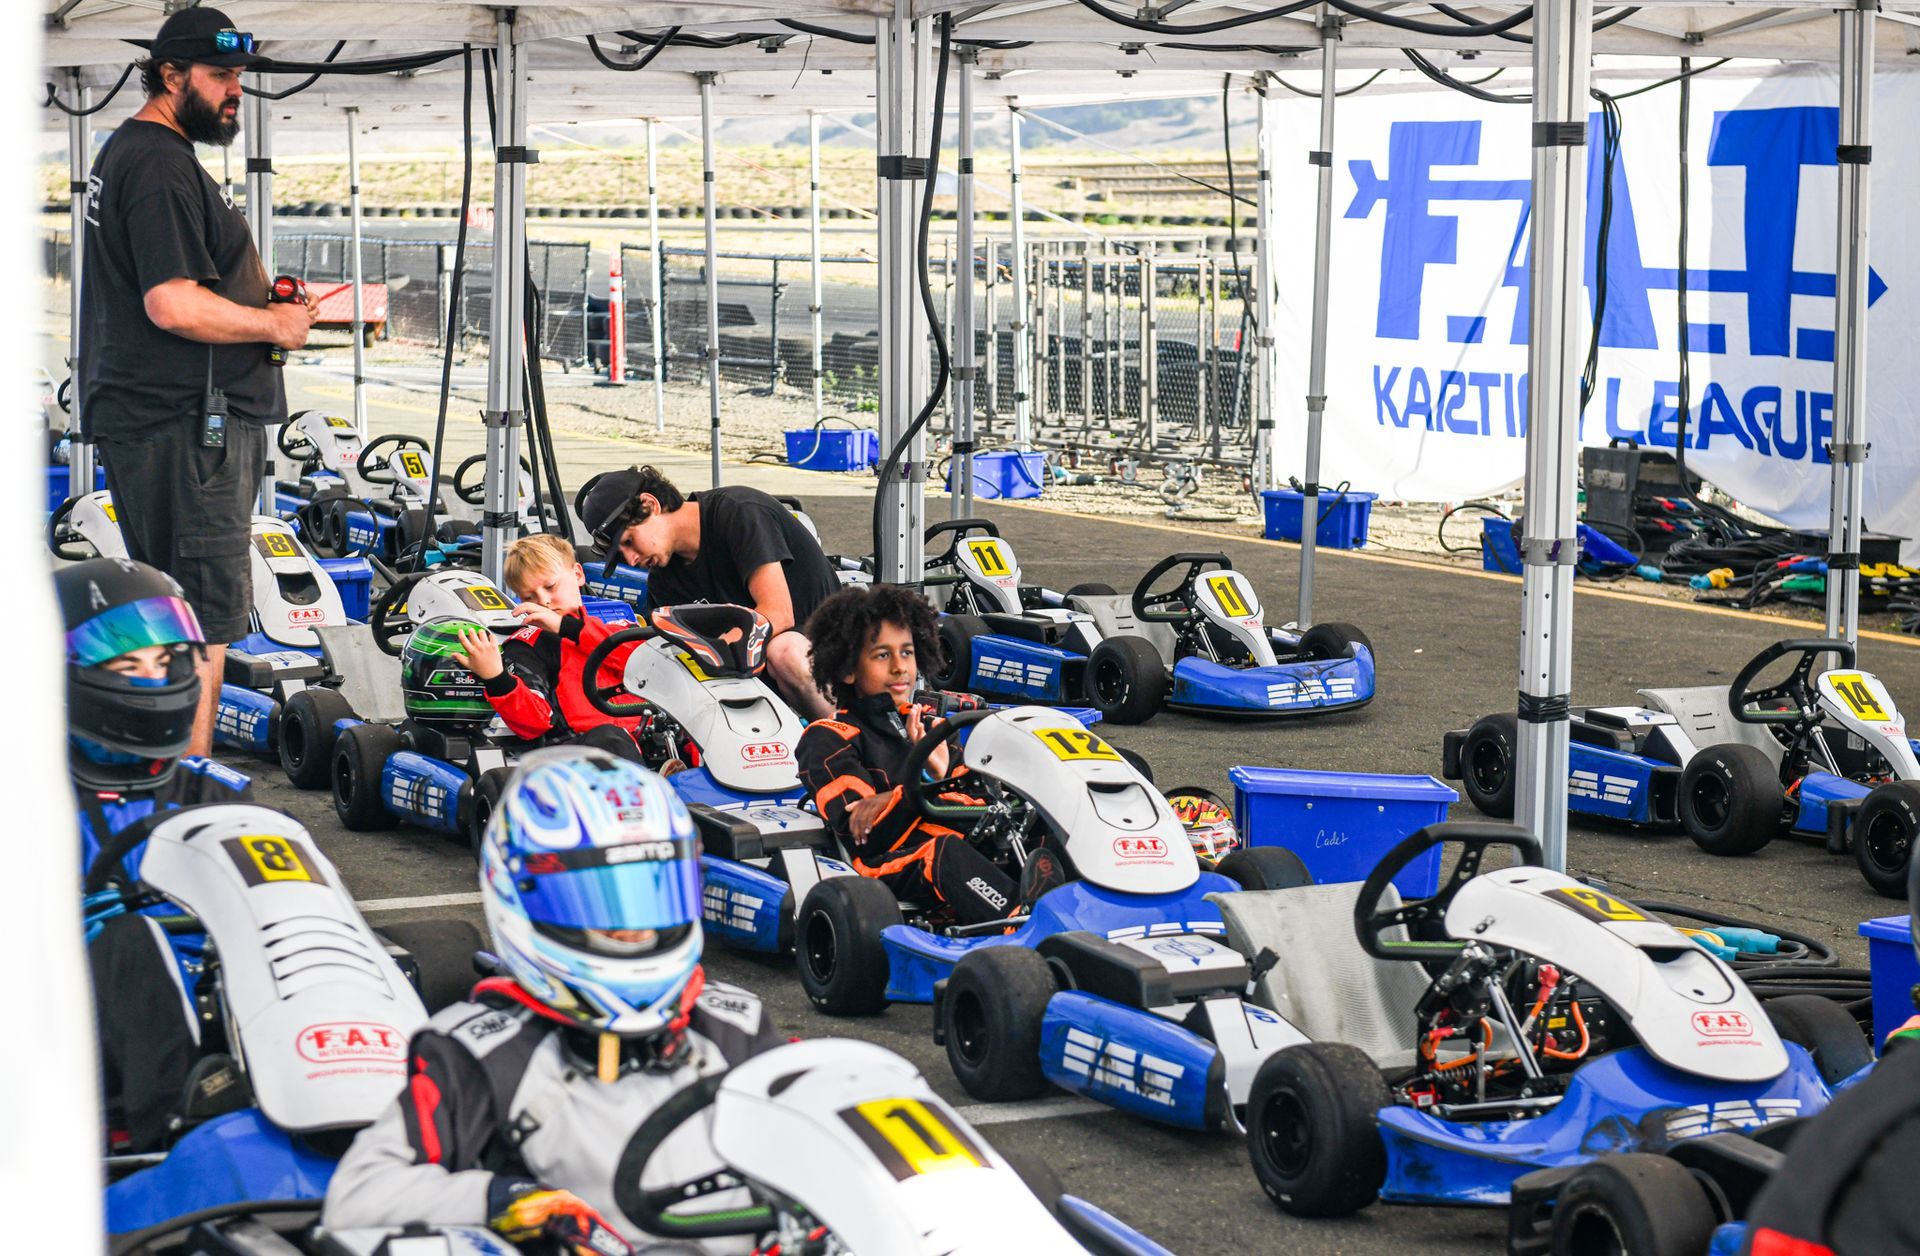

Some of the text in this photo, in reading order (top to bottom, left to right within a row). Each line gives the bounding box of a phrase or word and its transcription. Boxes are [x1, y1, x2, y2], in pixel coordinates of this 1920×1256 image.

[1373, 364, 1836, 465] KARTI LEAGUE
[406, 456, 421, 475] 5
[267, 535, 291, 553] 8
[972, 546, 1005, 571] 11
[473, 589, 502, 606] 6
[1217, 582, 1240, 610] 1
[1835, 681, 1883, 714] 14
[1045, 731, 1117, 756] 12
[250, 839, 298, 871] 8
[1573, 888, 1635, 915] 2
[885, 1107, 951, 1156] 1
